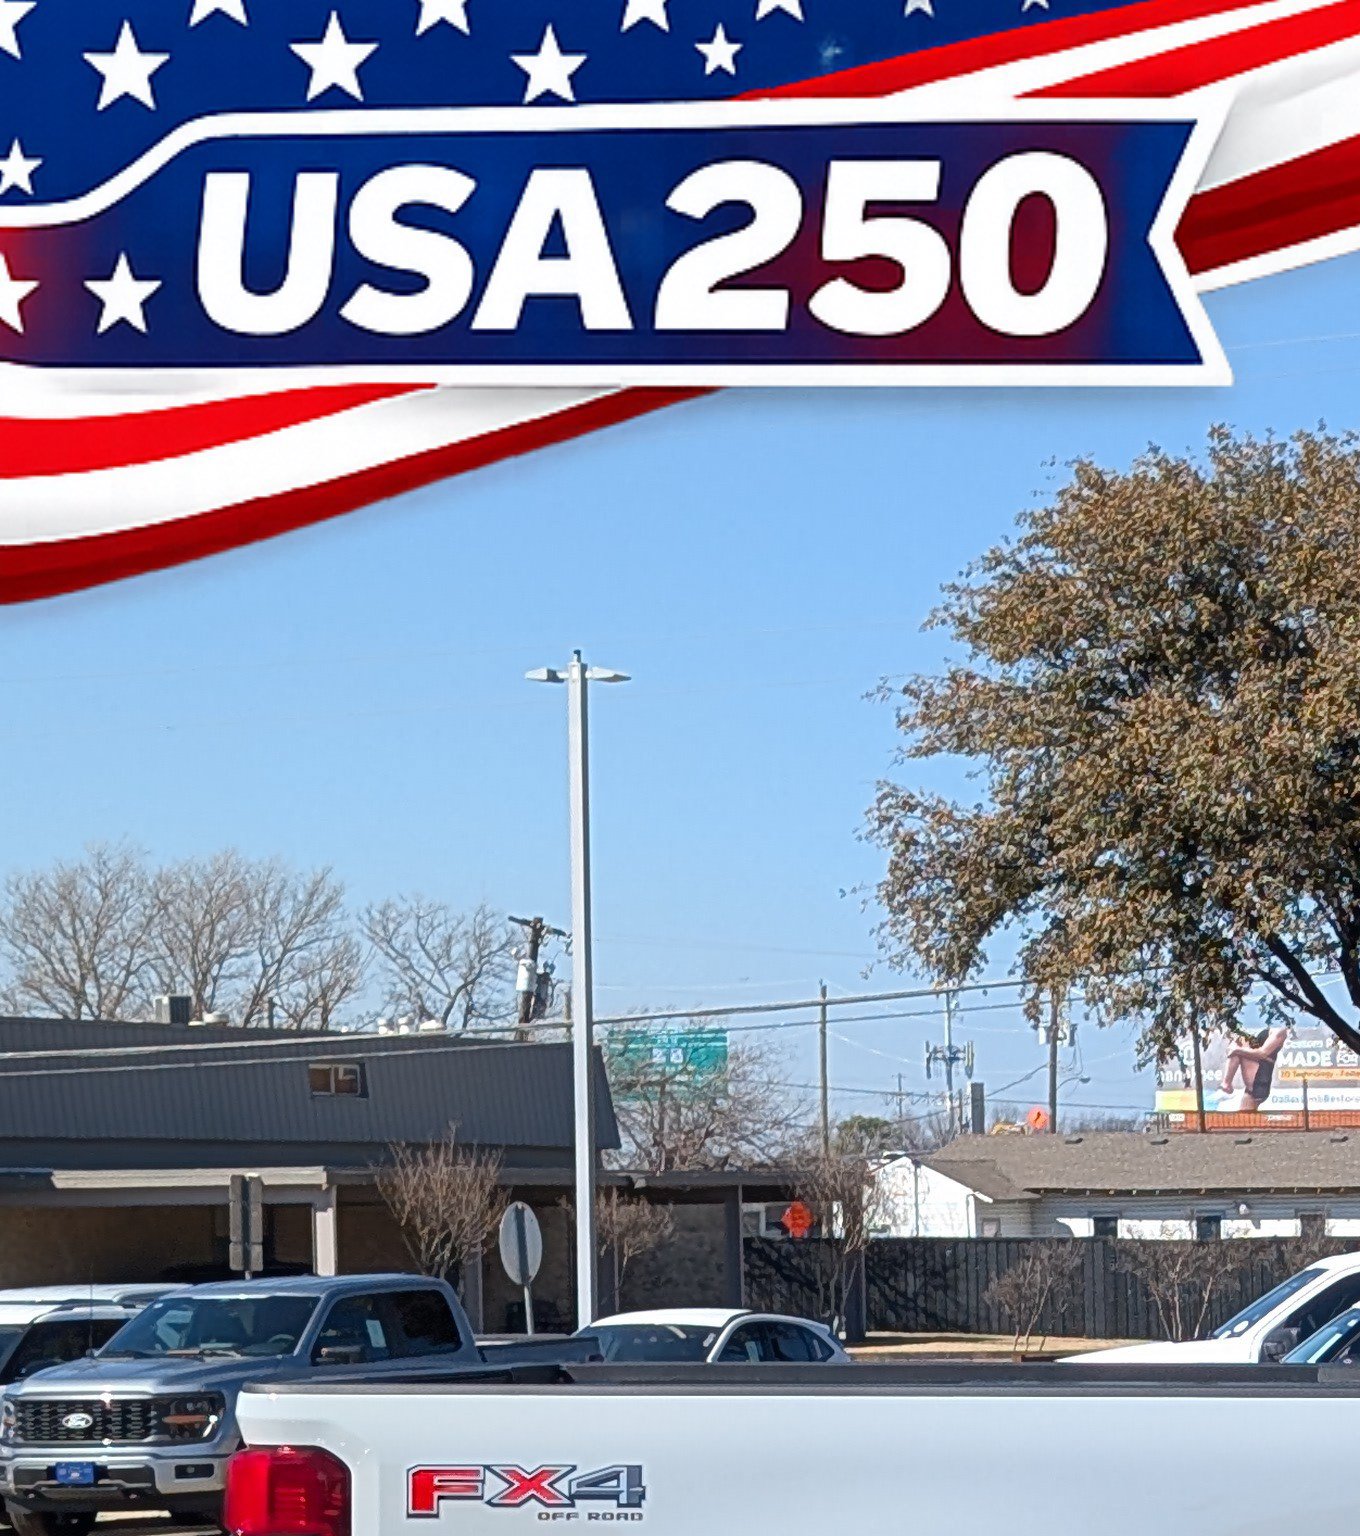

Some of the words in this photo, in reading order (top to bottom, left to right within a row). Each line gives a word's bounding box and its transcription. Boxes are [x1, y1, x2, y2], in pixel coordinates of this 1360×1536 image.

[1278, 1051, 1333, 1067] MADE
[406, 1464, 646, 1518] FX4
[537, 1512, 579, 1521] OFF
[588, 1512, 643, 1521] ROAD
